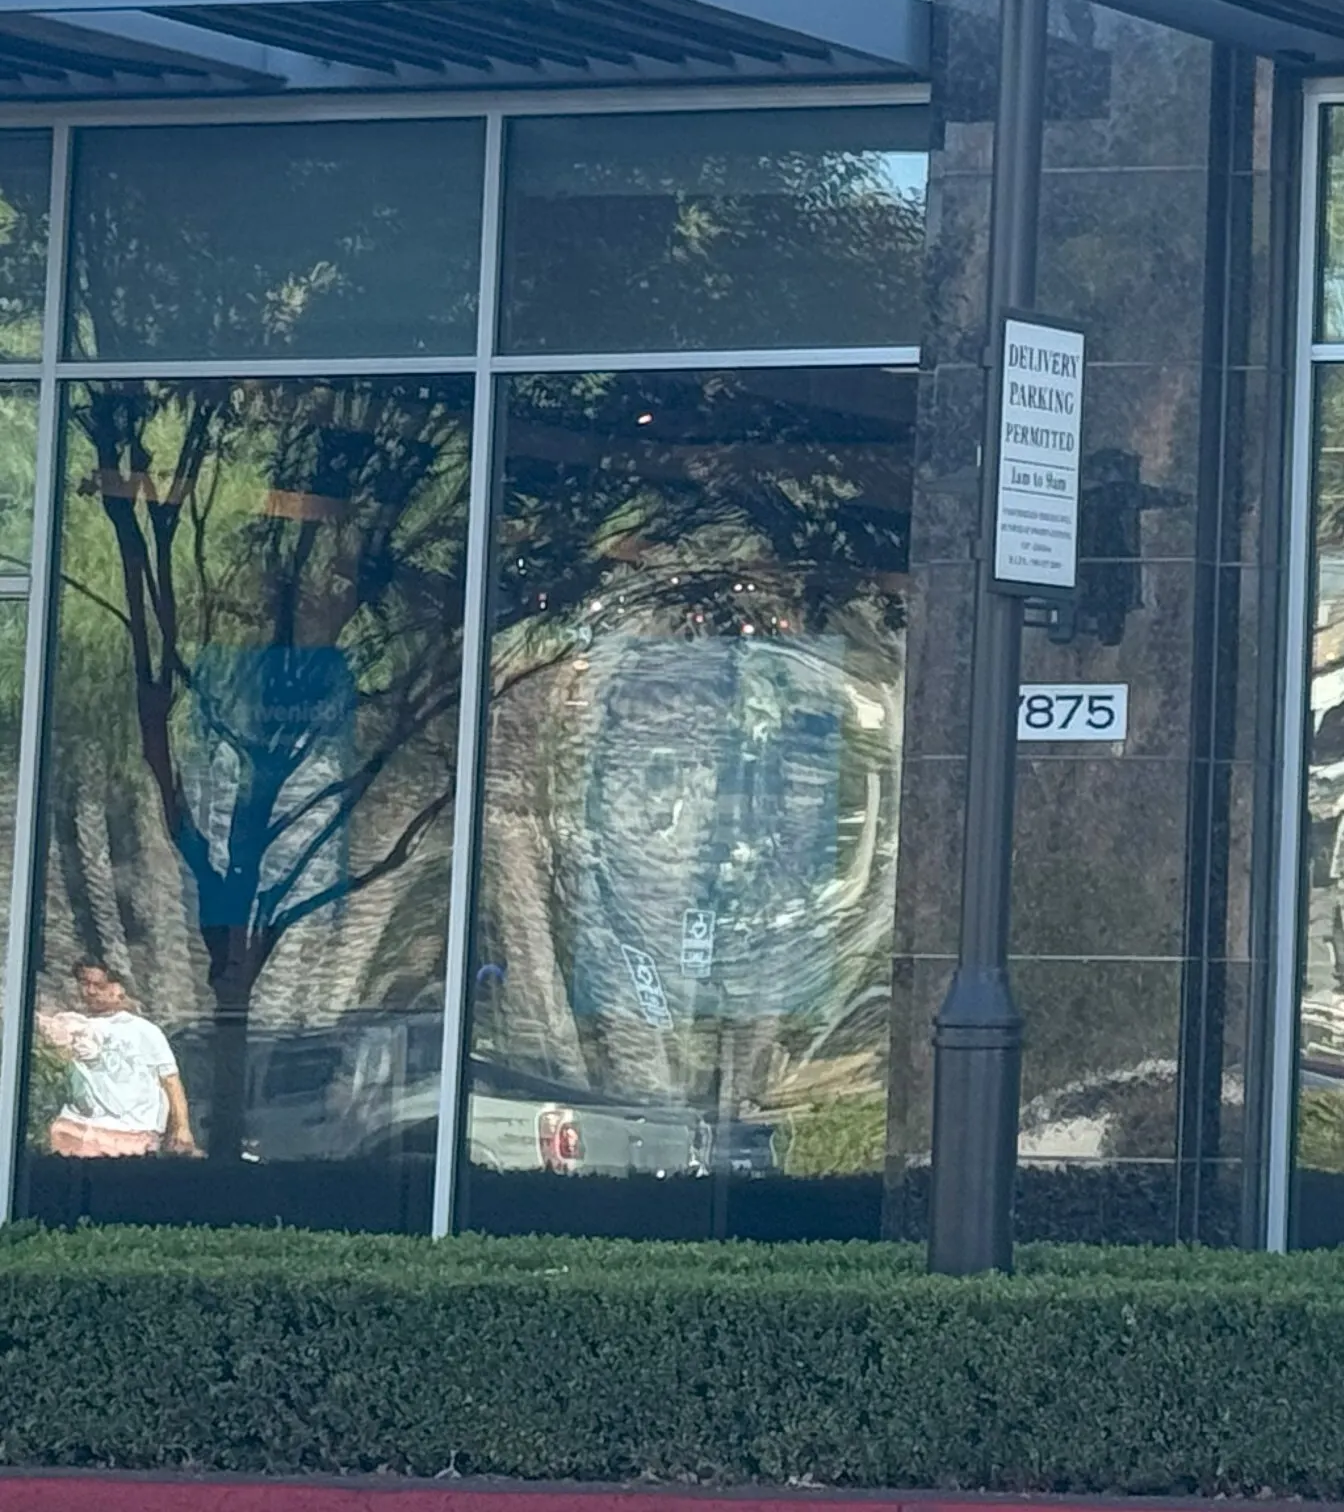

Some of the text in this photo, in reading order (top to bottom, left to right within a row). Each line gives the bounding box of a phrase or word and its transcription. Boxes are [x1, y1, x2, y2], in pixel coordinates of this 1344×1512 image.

[1008, 343, 1080, 379] DELIVERY
[1009, 381, 1075, 416] PARKING
[1005, 421, 1075, 453] PERMITTED
[1019, 695, 1114, 729] 875
